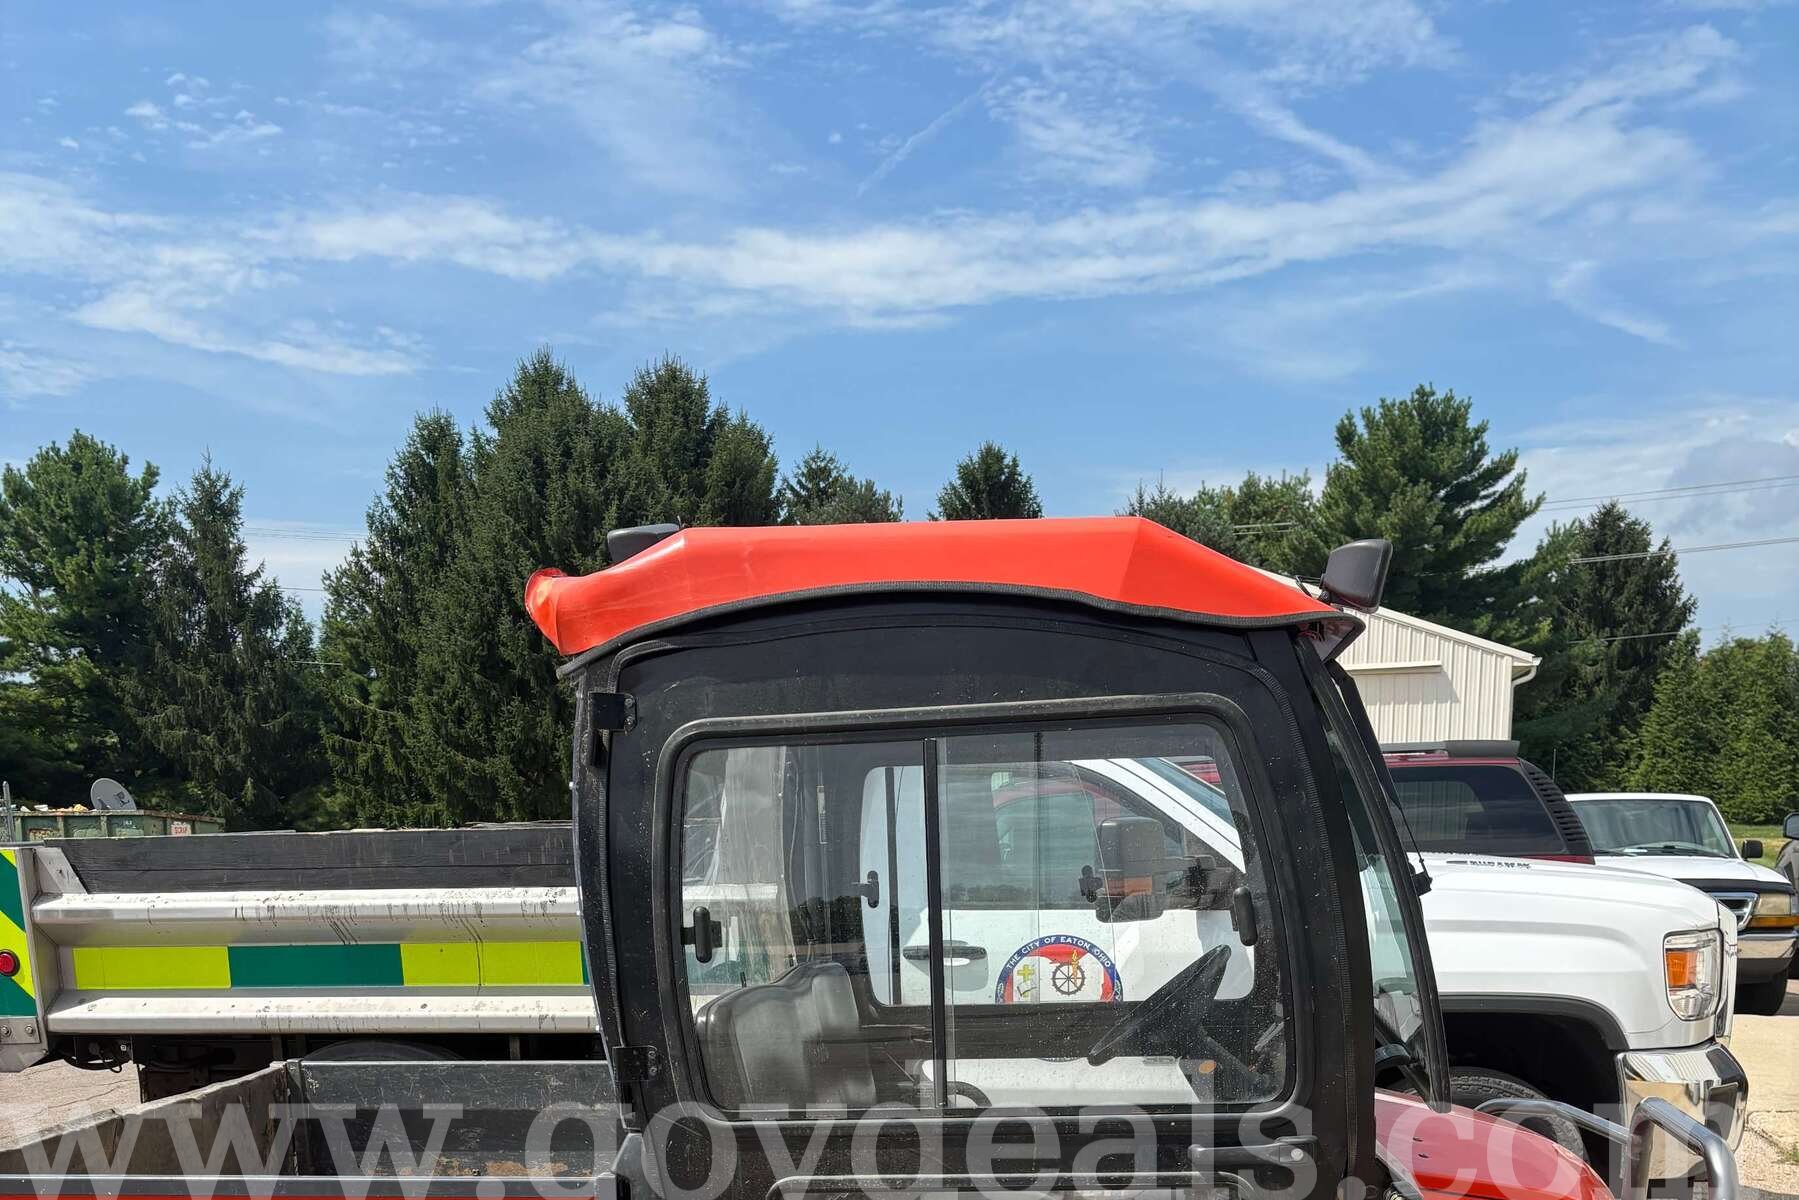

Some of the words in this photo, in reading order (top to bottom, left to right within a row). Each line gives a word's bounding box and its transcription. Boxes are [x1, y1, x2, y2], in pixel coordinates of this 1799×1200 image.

[1007, 955, 1021, 970] THE
[1022, 941, 1040, 954] CITY
[1045, 936, 1057, 944] OF
[1093, 947, 1111, 968] OHIO
